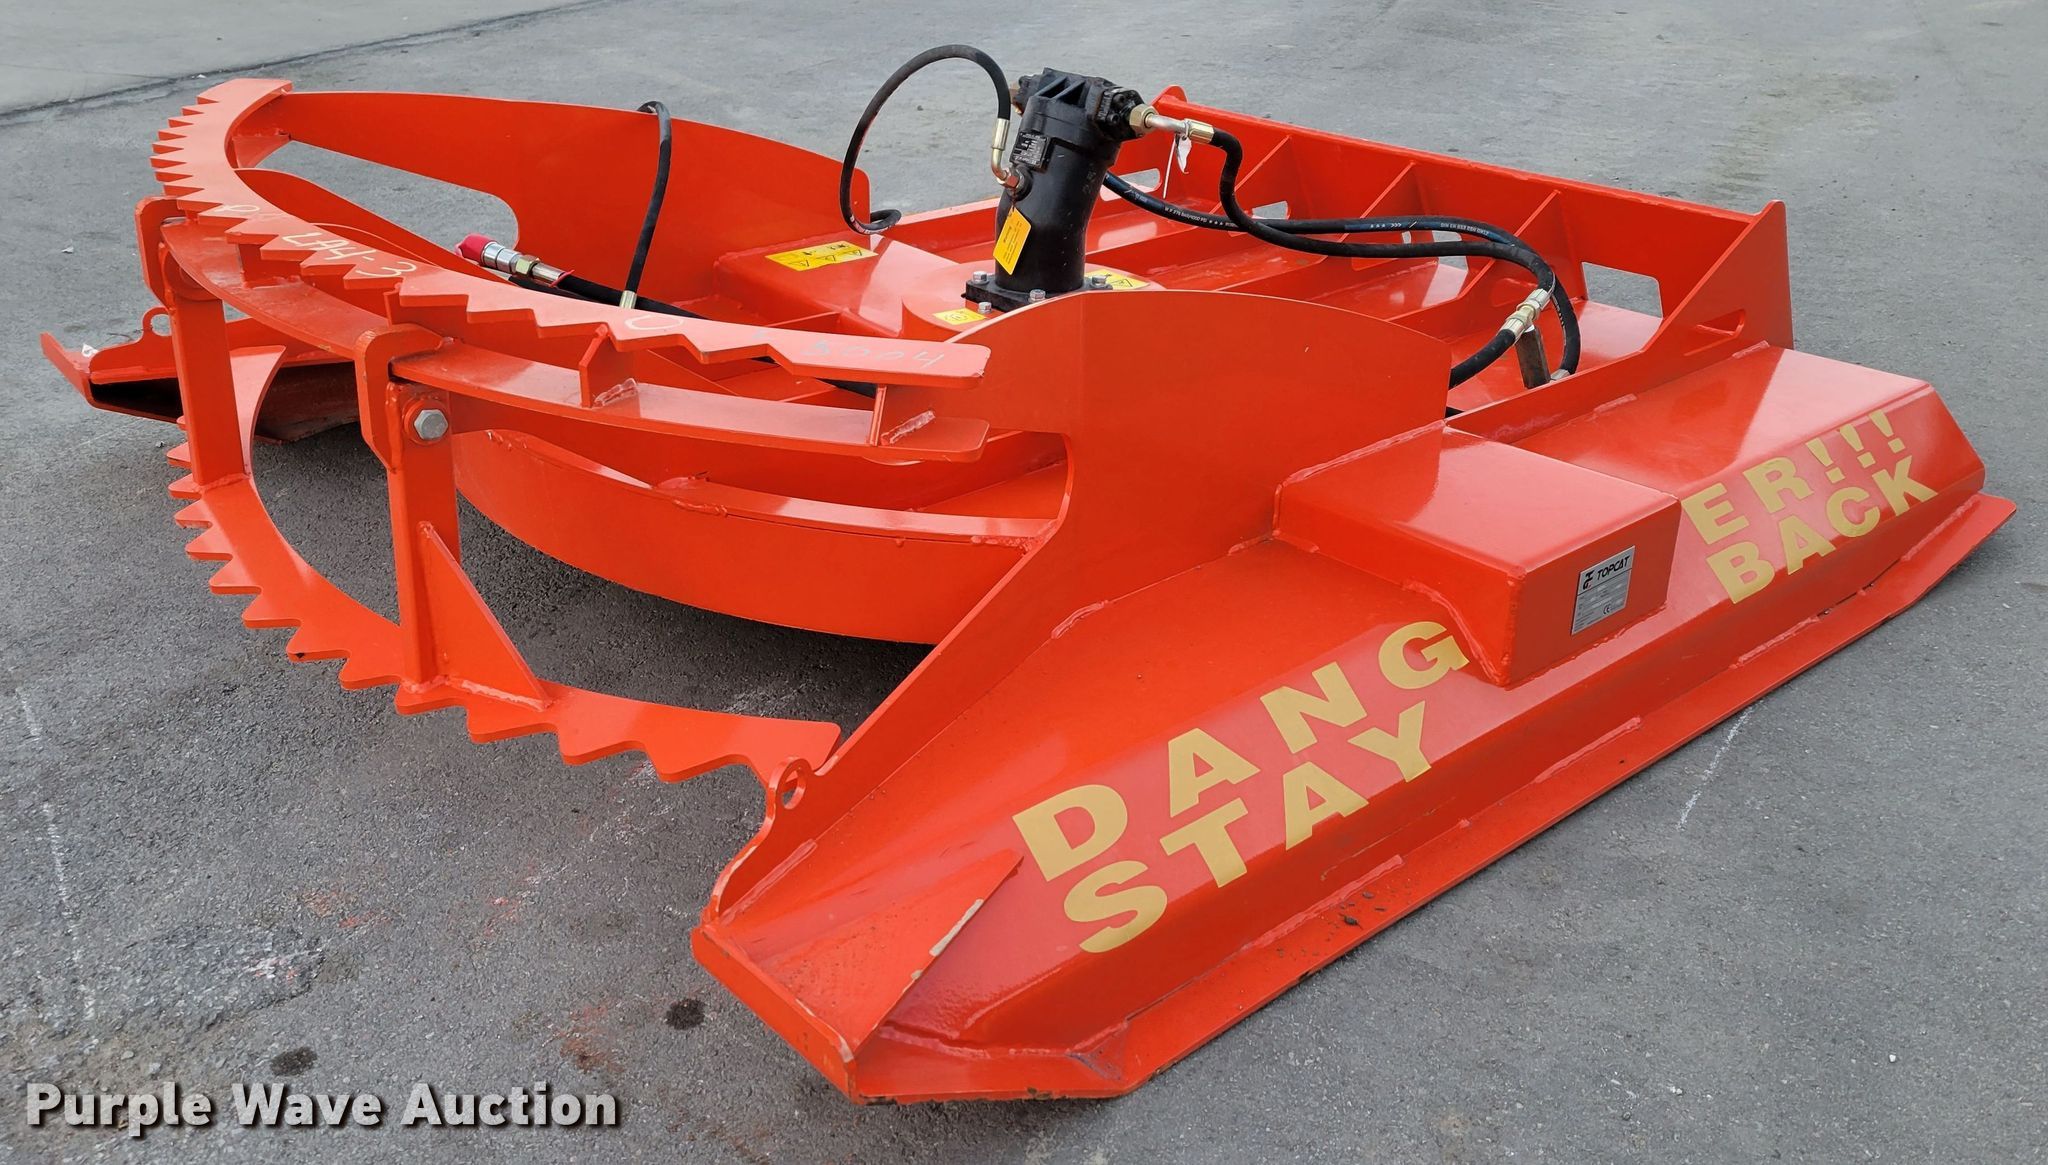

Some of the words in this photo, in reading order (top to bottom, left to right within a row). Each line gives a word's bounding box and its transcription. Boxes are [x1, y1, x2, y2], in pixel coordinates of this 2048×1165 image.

[1597, 555, 1630, 580] TOPCAT
[1012, 621, 1470, 882] DANG
[1063, 701, 1431, 953] STAY
[1706, 455, 1939, 604] BACK
